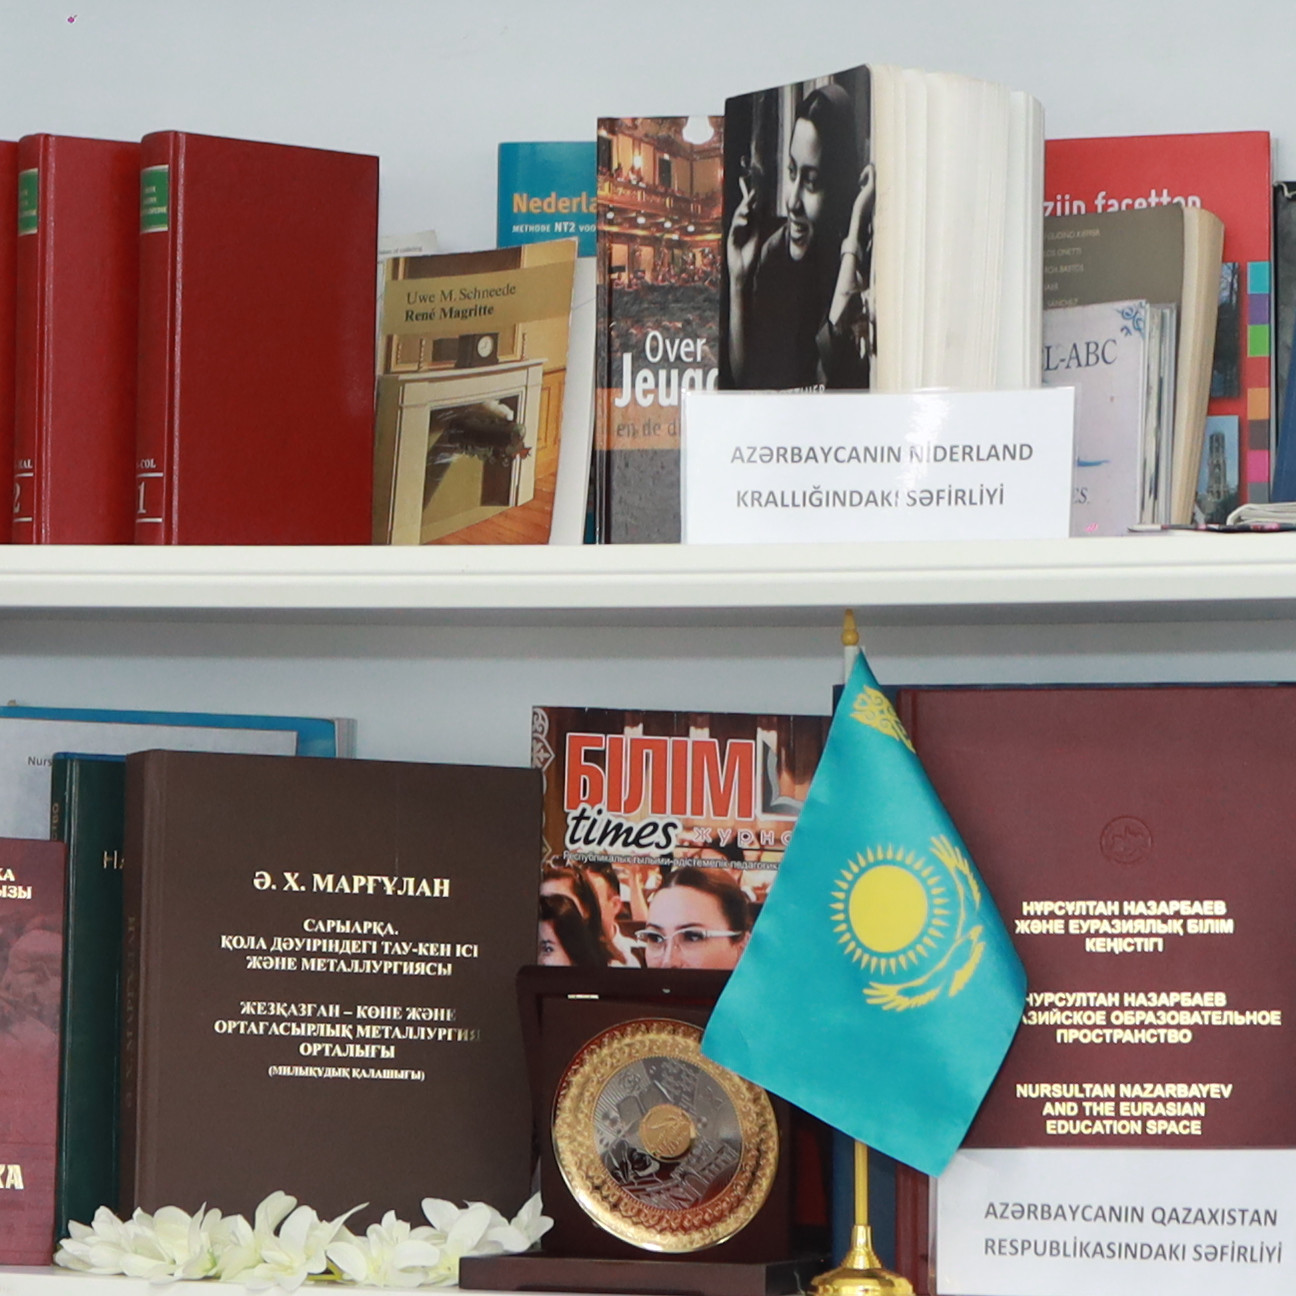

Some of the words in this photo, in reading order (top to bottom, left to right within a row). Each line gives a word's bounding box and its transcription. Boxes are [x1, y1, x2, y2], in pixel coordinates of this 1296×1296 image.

[554, 221, 576, 233] NT2
[406, 291, 436, 305] Uwe
[440, 289, 457, 302] M.
[459, 283, 517, 302] Schneede
[404, 307, 436, 322] René
[439, 304, 495, 320] Magritte
[645, 330, 707, 363] Over
[643, 418, 661, 437] de
[730, 445, 902, 465] AZƏRBAYCANIN
[909, 442, 1034, 464] NİDERLAND
[137, 481, 147, 514] 1
[905, 482, 1005, 507] SƏFİRLİYİ
[563, 731, 756, 822] БІЛІМ
[567, 805, 680, 851] times
[283, 871, 306, 892] Х.
[1122, 900, 1228, 917] НАЗАРБАЕВ
[302, 918, 399, 938] САРЫАРҚА.
[1068, 918, 1185, 938] ЕУРАЗИЯЛЫҚ
[1187, 918, 1235, 935] БІЛІМ
[220, 935, 267, 951] ҚОЛА
[381, 940, 452, 958] ТАУ-КЕН
[246, 955, 298, 972] ЖӘНЕ
[301, 957, 453, 977] МЕТАЛЛУРГИЯСЫ
[1123, 992, 1227, 1008] НАЗАРБАЕВ
[1110, 1010, 1283, 1026] ОБРАЗОВАТЕЛЬНОЕ
[1056, 1028, 1193, 1044] ПРОСТРАНСТВО
[1015, 1083, 1116, 1099] NURSULTAN
[1119, 1083, 1234, 1100] NAZARBAYEV
[1042, 1101, 1078, 1117] AND
[1082, 1101, 1116, 1117] THE
[1119, 1101, 1206, 1117] EURASIAN
[1045, 1120, 1143, 1136] EDUCATION
[1146, 1120, 1203, 1136] SPACE
[984, 1202, 1145, 1224] AZƏRBAYCANIN
[1150, 1206, 1279, 1229] QAZAXISTAN
[1192, 1241, 1284, 1265] SƏFİRLİYİ
